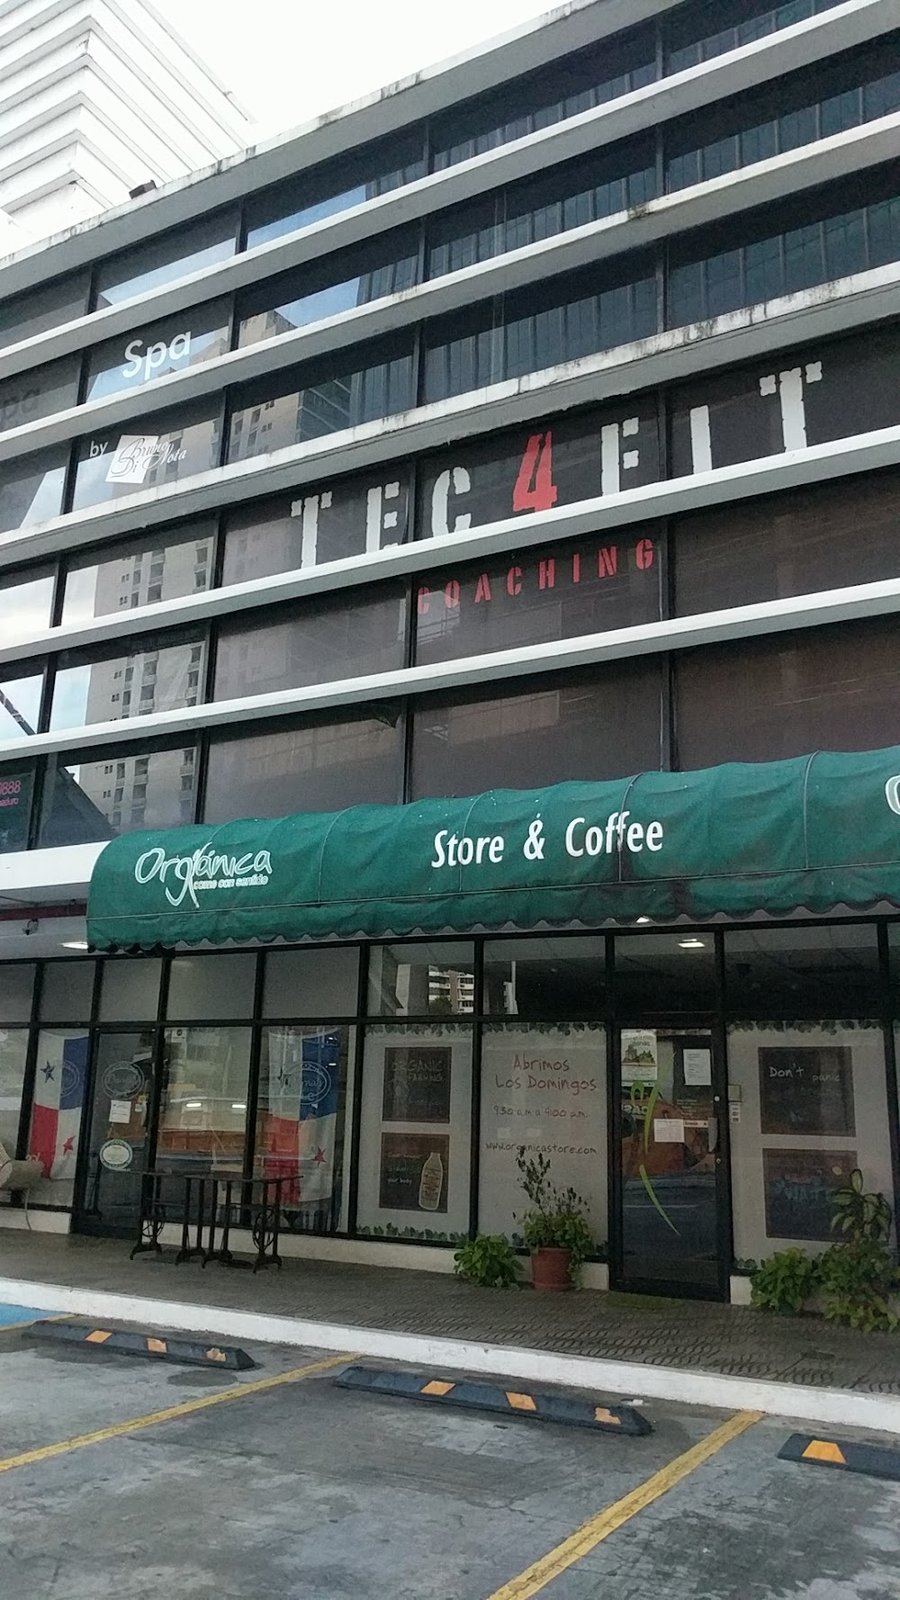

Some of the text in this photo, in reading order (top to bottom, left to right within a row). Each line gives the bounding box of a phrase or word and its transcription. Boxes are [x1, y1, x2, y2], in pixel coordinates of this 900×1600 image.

[122, 330, 192, 381] Spa
[89, 440, 109, 458] by
[416, 537, 655, 615] COACHING
[431, 811, 664, 869] Store & Coffee
[512, 1053, 571, 1072] Abrimos
[768, 1063, 841, 1082] Don't panic
[495, 1074, 598, 1096] Los Domingos
